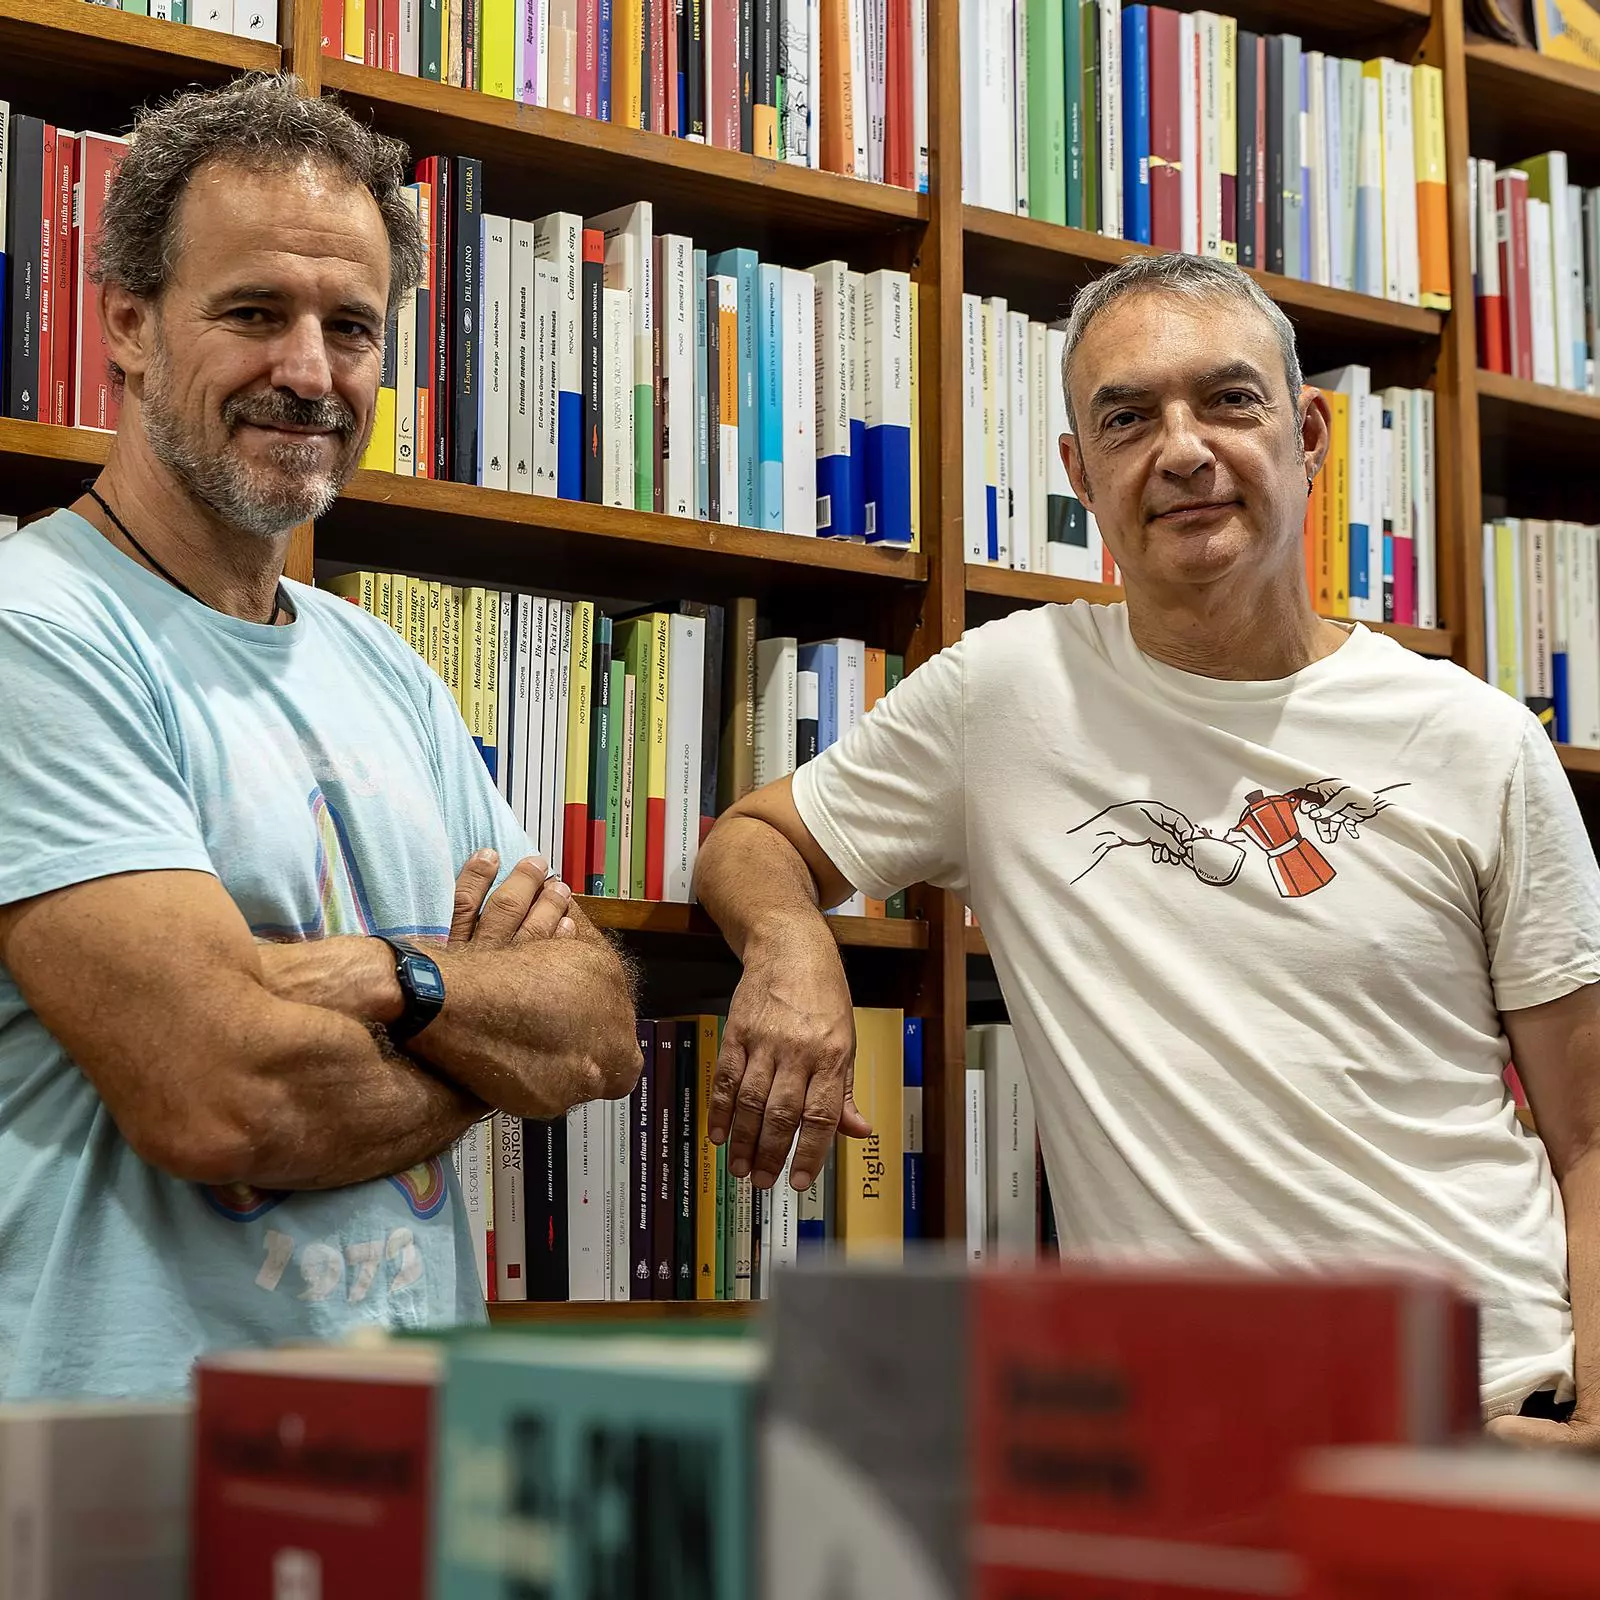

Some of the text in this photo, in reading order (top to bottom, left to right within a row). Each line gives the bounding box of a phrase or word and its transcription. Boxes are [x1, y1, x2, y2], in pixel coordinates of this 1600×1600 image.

[843, 72, 853, 140] CARCOMA
[567, 226, 576, 300] Camino de sirga
[837, 272, 847, 293] Jesús
[838, 296, 846, 309] de
[893, 282, 902, 339] Lectura fácil
[837, 312, 847, 341] Teresa
[848, 307, 857, 341] Lectura
[838, 363, 847, 390] tardes
[381, 583, 390, 616] kárate
[431, 590, 440, 610] Sed
[488, 638, 495, 647] de
[549, 634, 557, 656] Pica't
[562, 609, 572, 653] Psicopomp
[579, 608, 590, 669] Psicopompo
[451, 647, 459, 689] Metafísica
[474, 647, 482, 689] Metafísica
[488, 649, 496, 692] Metafísica
[656, 620, 667, 702] Los vulnerables
[502, 1131, 510, 1151] SOY
[502, 1155, 510, 1169] YO
[862, 1134, 884, 1199] Piglia
[470, 1195, 478, 1205] DE
